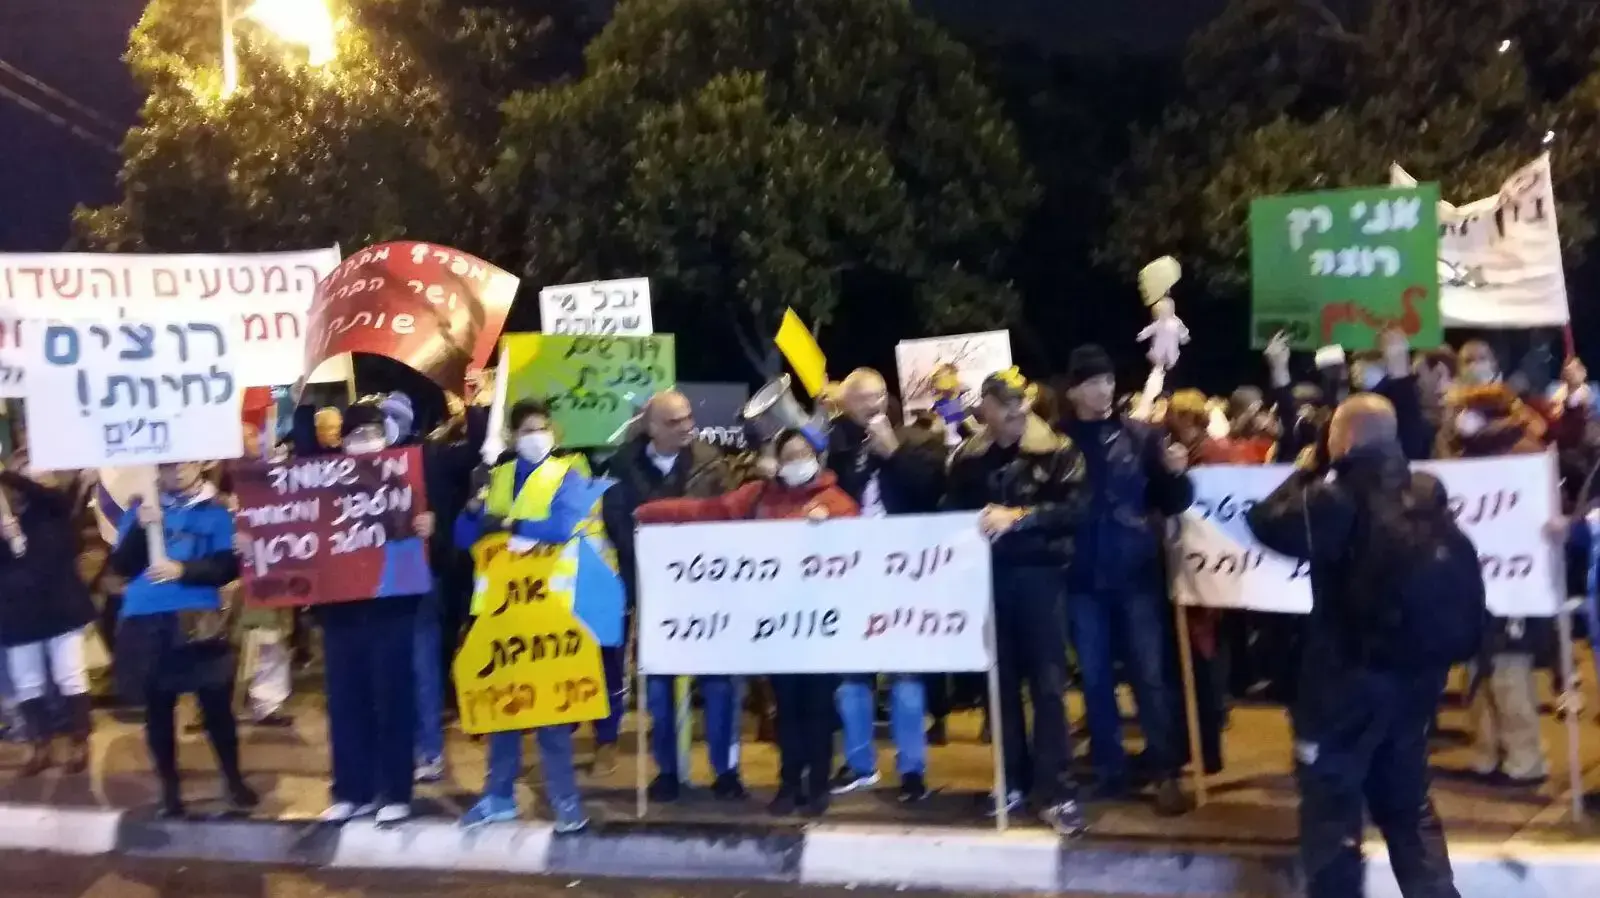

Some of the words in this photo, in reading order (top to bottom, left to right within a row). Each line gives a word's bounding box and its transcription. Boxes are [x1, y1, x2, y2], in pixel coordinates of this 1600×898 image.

[1286, 204, 1333, 251] רק
[1350, 196, 1421, 235] אני
[1309, 245, 1400, 277] רוצה
[4, 266, 132, 299] והשדו
[152, 264, 319, 299] המטעים
[407, 278, 457, 311] ושר
[76, 365, 234, 416] לחיות!
[373, 452, 409, 481] מי
[665, 553, 781, 583] התפטר
[800, 550, 861, 582] יהב
[884, 545, 955, 582] יונה
[1185, 548, 1263, 575] יותר
[491, 575, 546, 618] את
[660, 611, 731, 642] יותר
[751, 607, 840, 643] שווים
[862, 607, 968, 641] החיים
[477, 629, 582, 679] הרחבת
